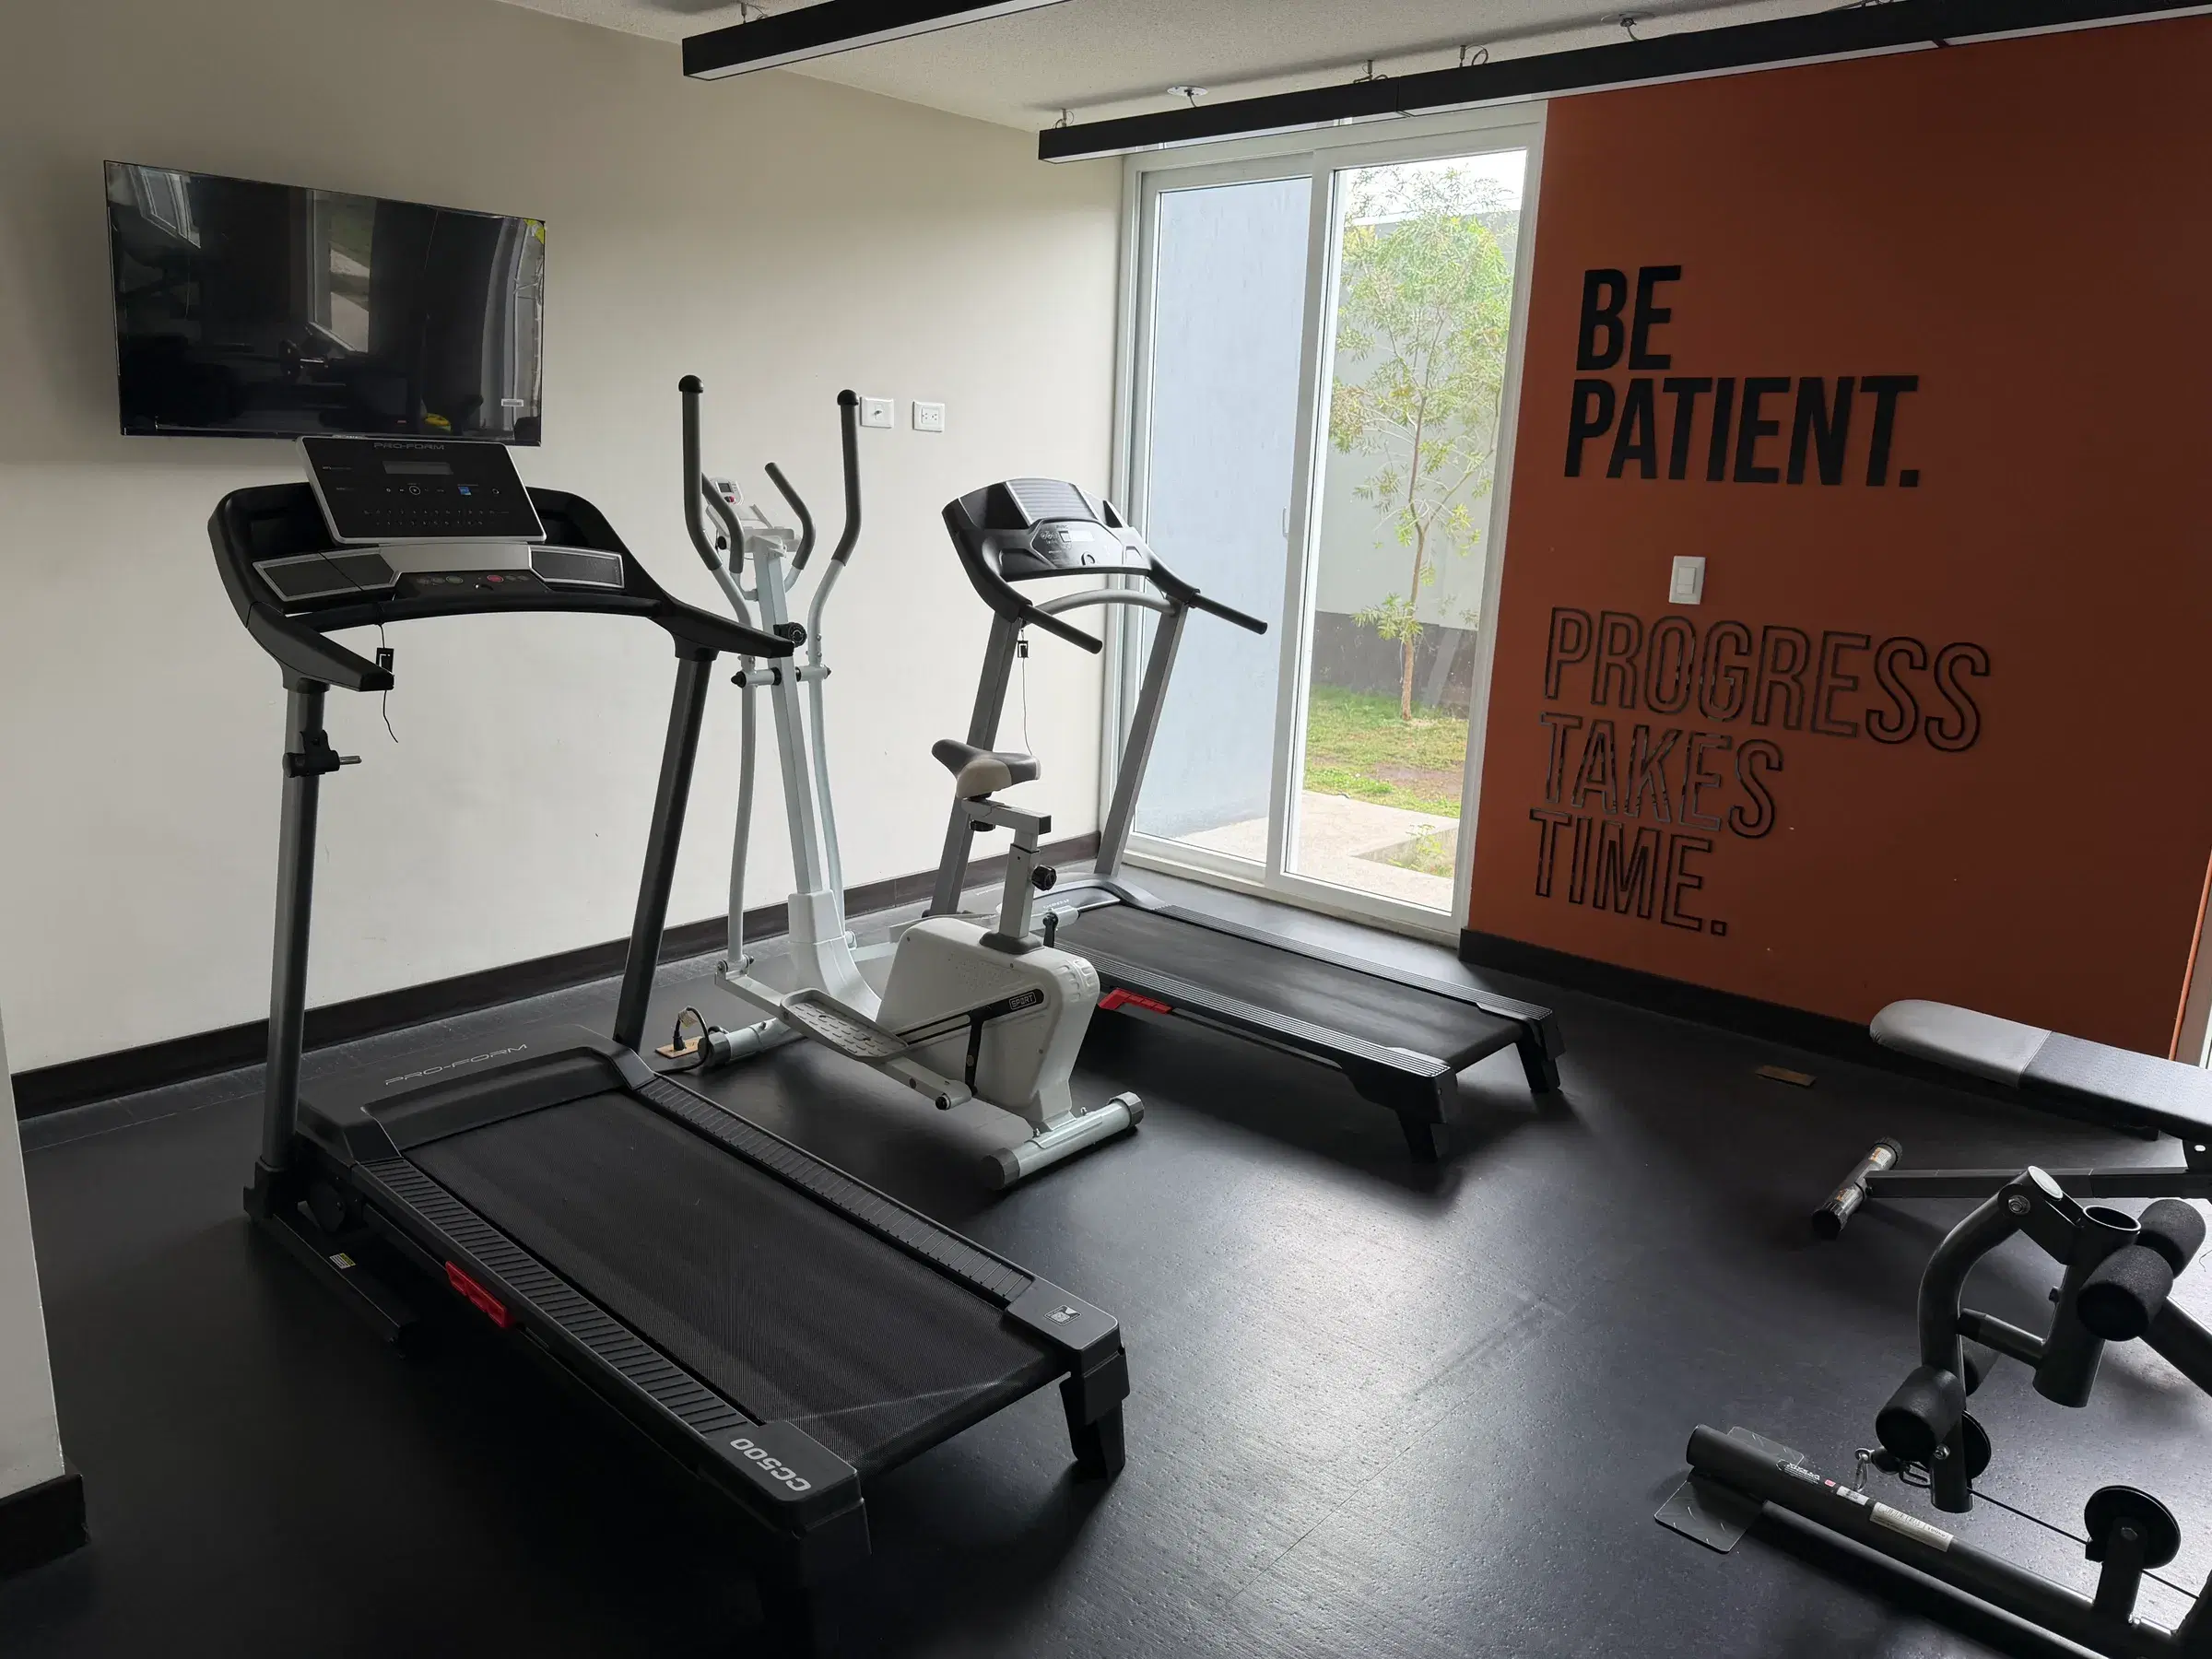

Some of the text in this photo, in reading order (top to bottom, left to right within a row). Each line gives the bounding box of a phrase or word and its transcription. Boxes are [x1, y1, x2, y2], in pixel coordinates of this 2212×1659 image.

[1576, 265, 1682, 371] BE
[1564, 375, 1921, 488] PATIENT.
[1544, 606, 1991, 752] PROGRESS
[1539, 712, 1784, 840] TAKES
[1529, 807, 1729, 937] TIME.
[1010, 994, 1035, 1008] SPORT
[385, 1043, 528, 1086] PRO-FORM
[730, 1438, 812, 1492] CC500
